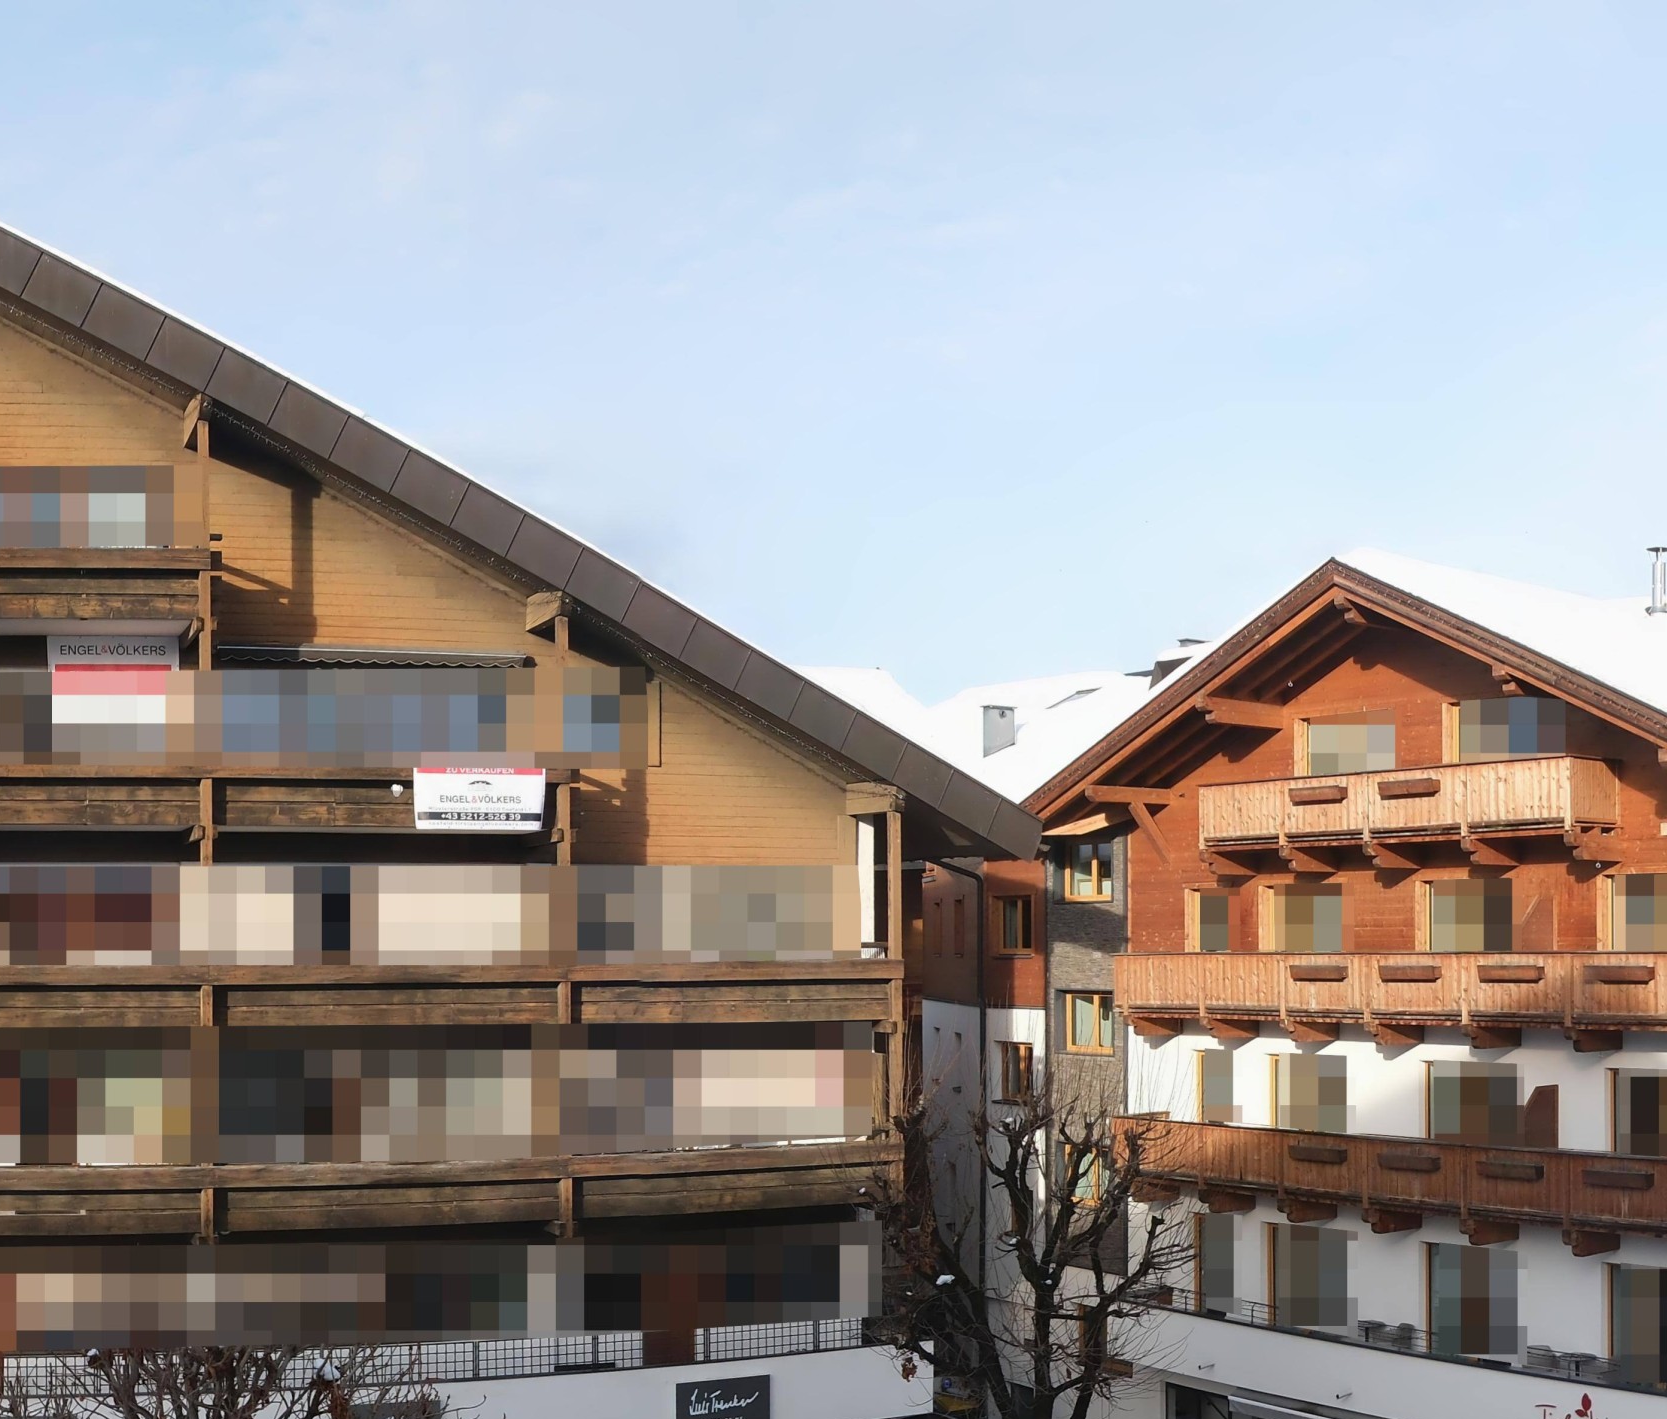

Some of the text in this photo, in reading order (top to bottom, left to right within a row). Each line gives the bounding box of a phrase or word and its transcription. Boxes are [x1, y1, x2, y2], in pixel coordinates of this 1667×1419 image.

[60, 643, 166, 655] ENGEL&VÖLKERS
[441, 812, 521, 821] +43 5212-526 39
